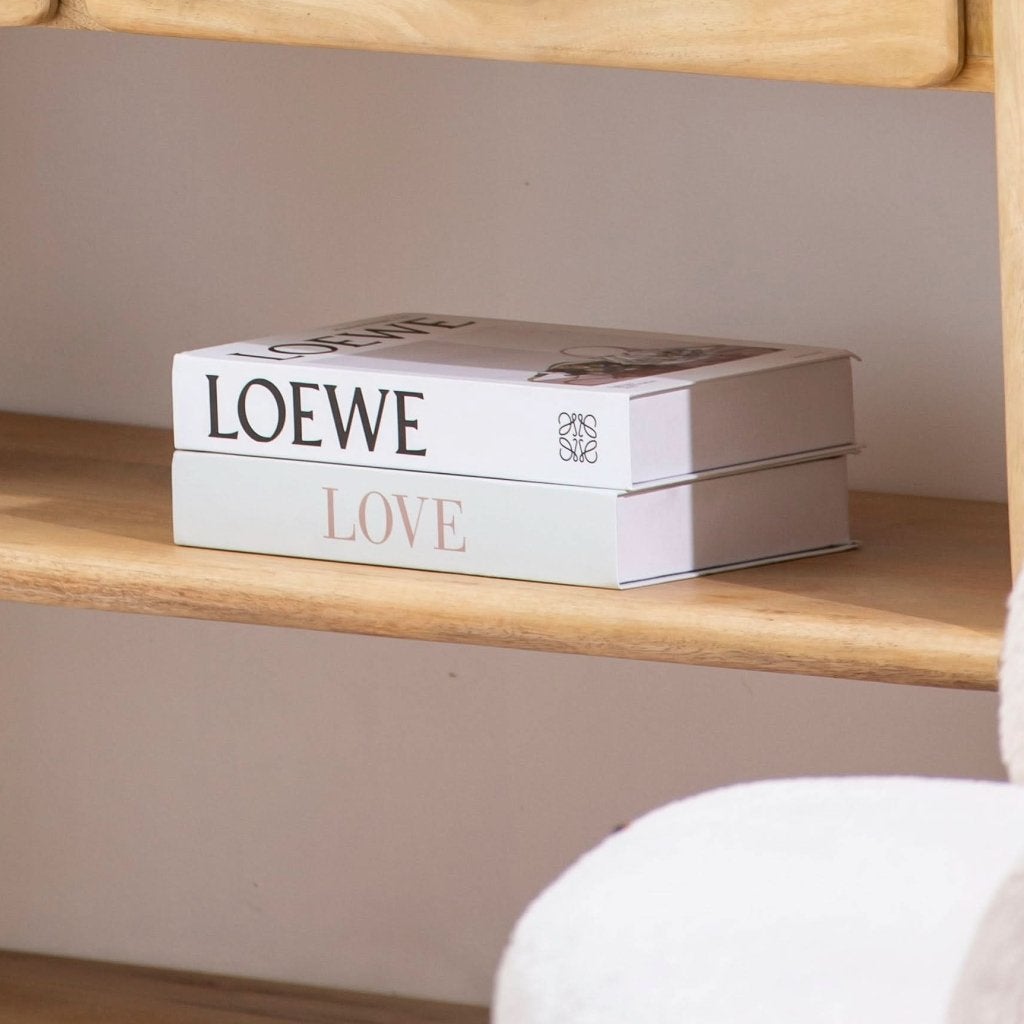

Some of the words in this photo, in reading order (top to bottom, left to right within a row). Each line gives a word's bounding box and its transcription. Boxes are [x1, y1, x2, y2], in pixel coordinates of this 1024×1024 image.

[227, 316, 475, 361] LOEWE
[205, 374, 427, 457] LOEWE
[322, 486, 467, 553] LOVE
